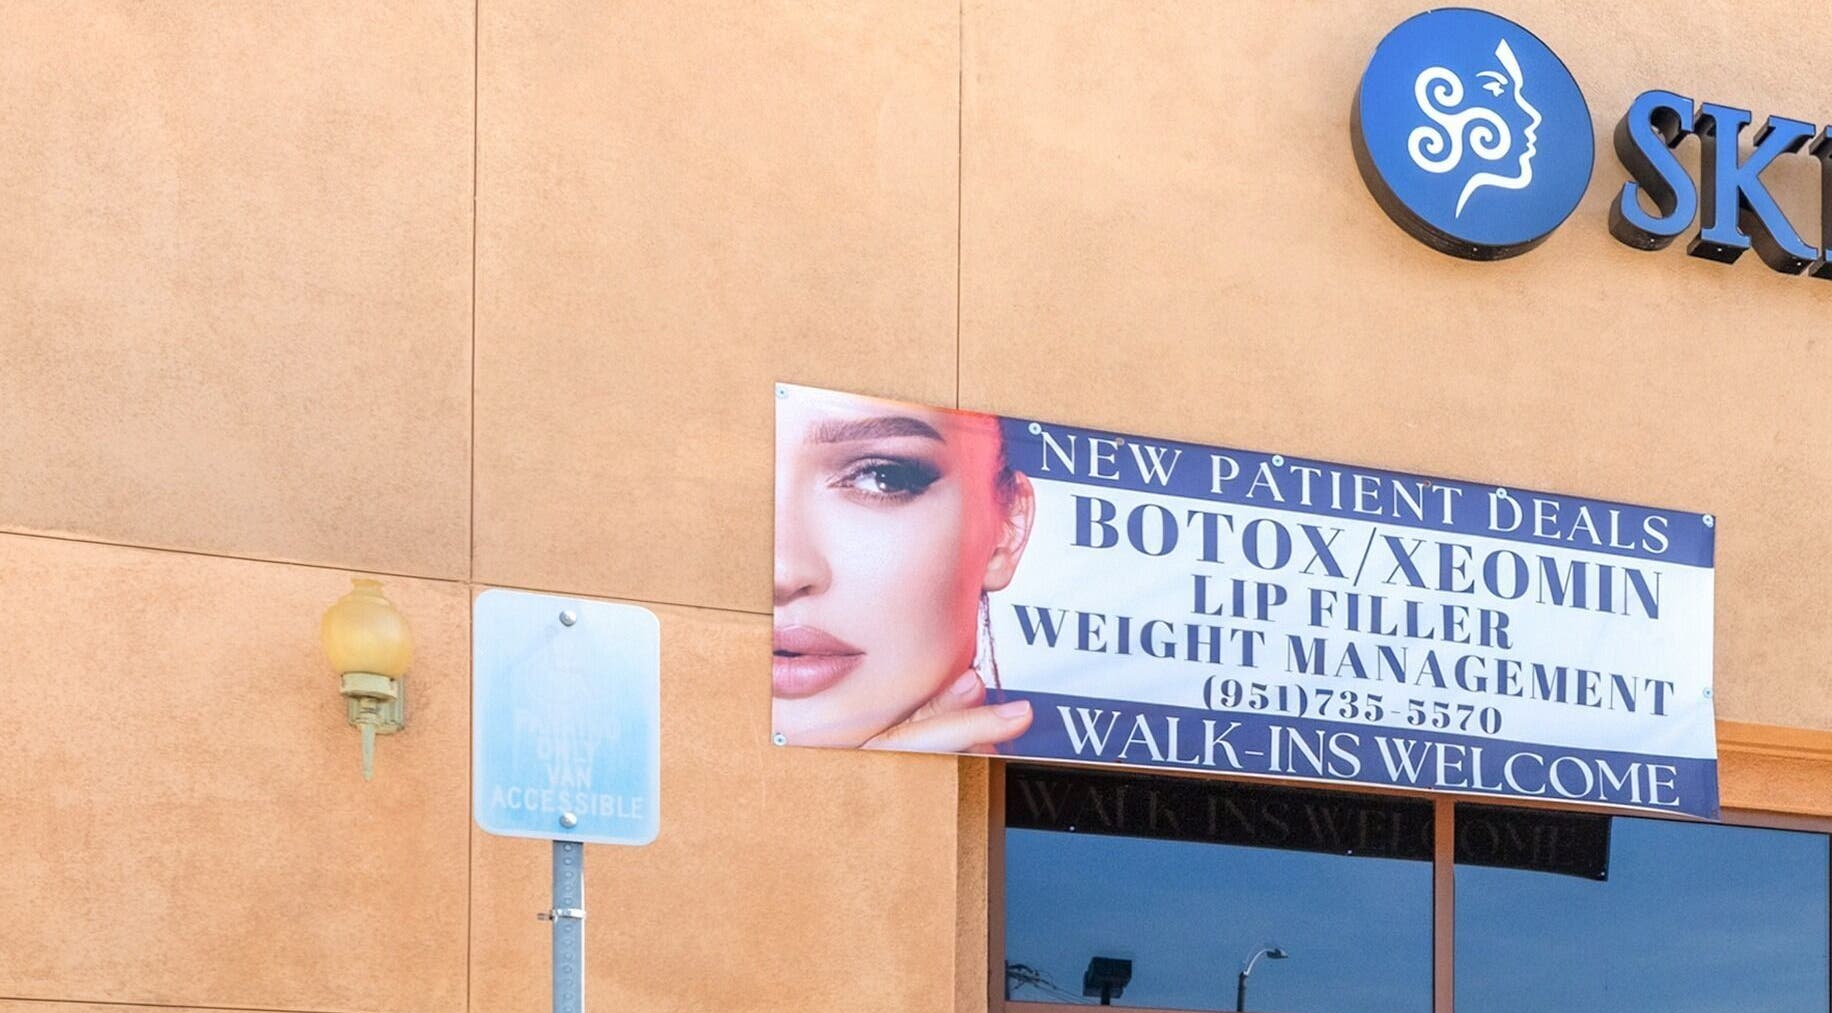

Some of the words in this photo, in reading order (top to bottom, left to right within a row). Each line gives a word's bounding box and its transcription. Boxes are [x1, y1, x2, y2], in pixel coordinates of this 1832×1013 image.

[1041, 431, 1182, 486] NEW
[1210, 454, 1462, 525] PATIENT
[1487, 491, 1669, 554] DEALS
[1071, 494, 1662, 620] BOTOX/XEOMIN
[1191, 574, 1288, 622] LIP
[1307, 587, 1514, 650] FILLER
[1011, 604, 1265, 668] WEIGHT
[1286, 634, 1674, 716] MANAGEMENT
[1203, 675, 1502, 734] (951)735-5570
[547, 764, 592, 789] VAN
[1057, 705, 1361, 779] WALK-INS
[1374, 736, 1680, 806] WELCOME
[490, 786, 643, 819] ACCESSIBLE
